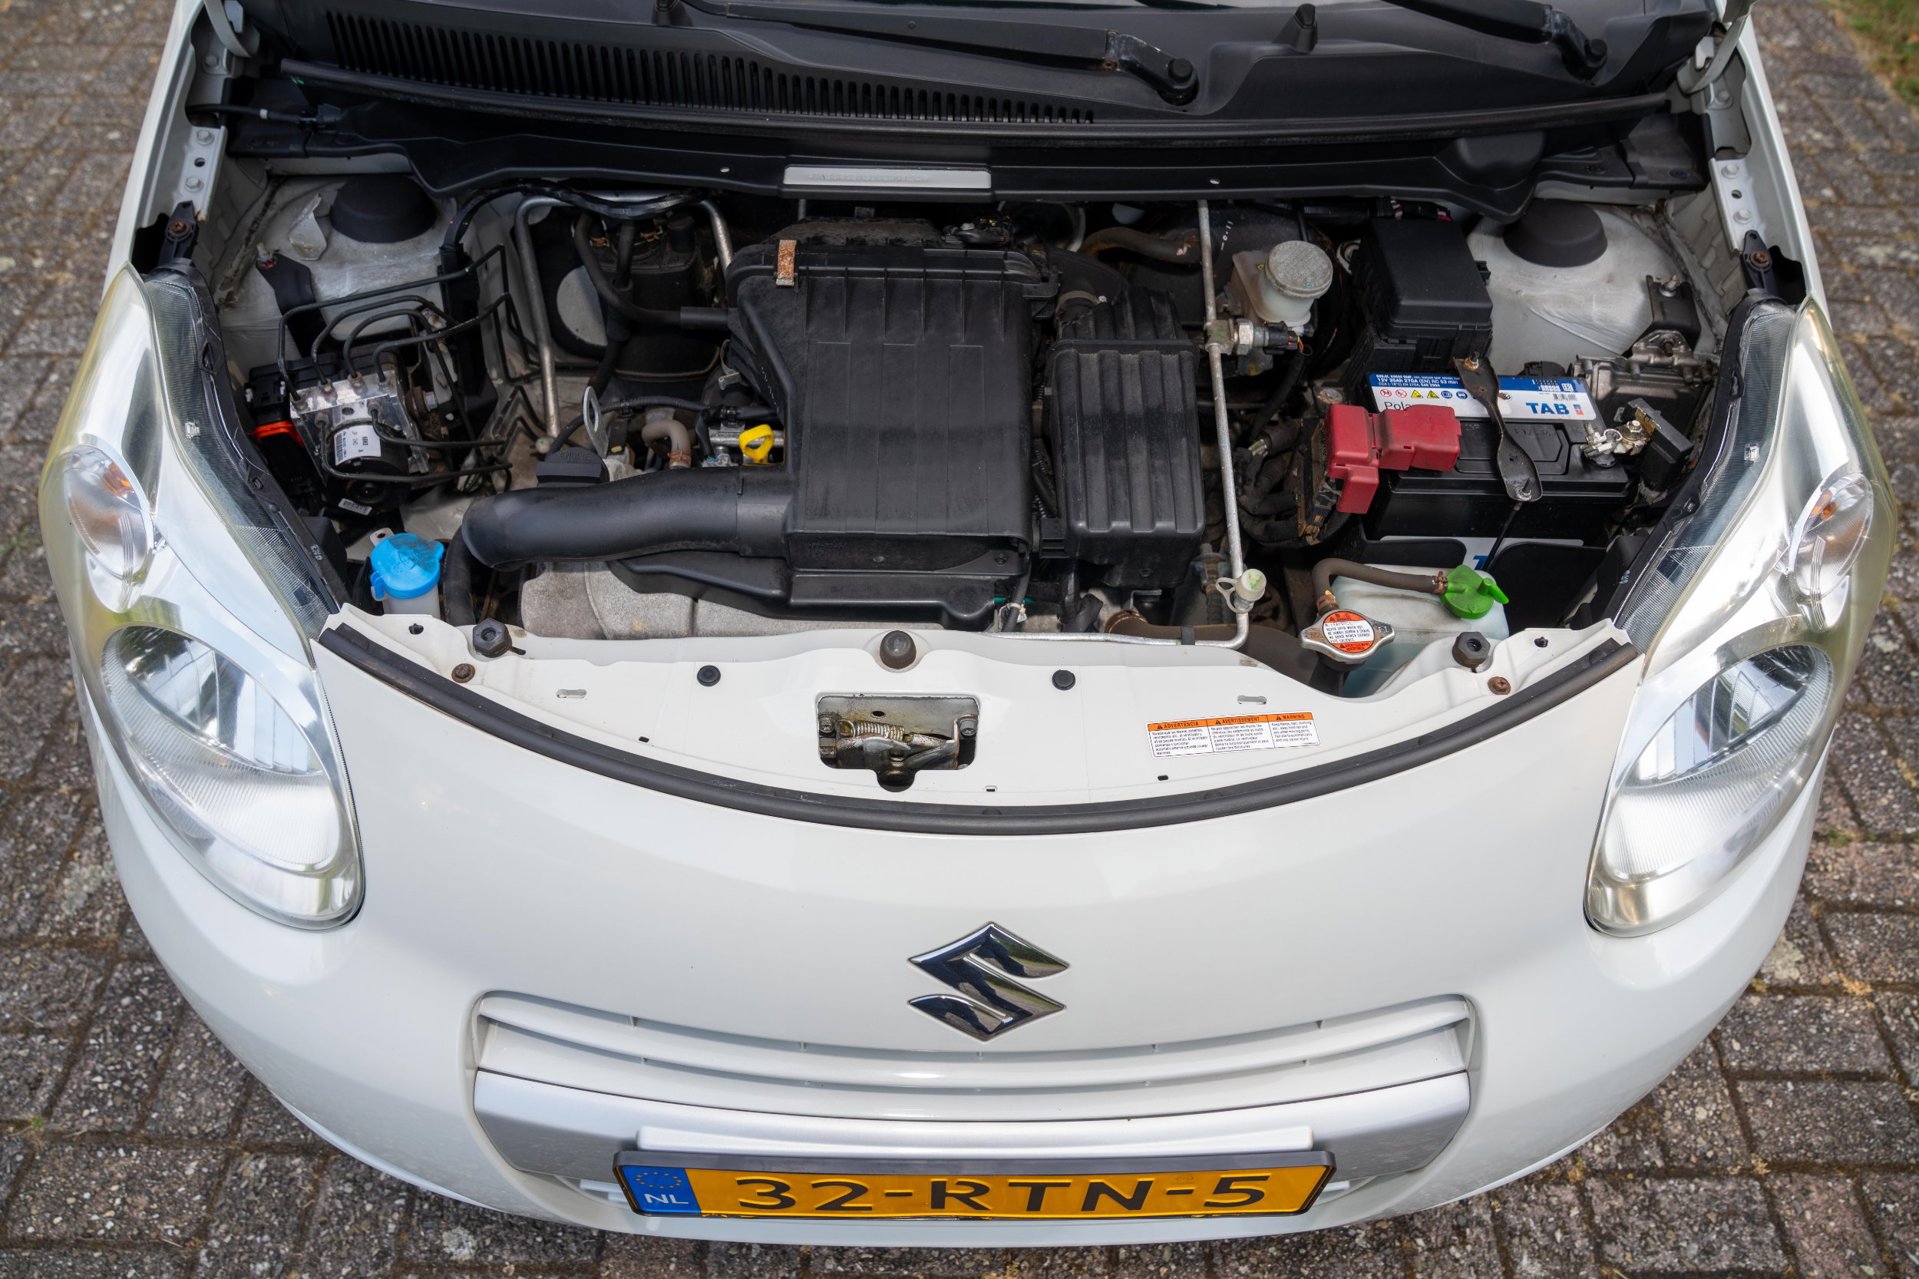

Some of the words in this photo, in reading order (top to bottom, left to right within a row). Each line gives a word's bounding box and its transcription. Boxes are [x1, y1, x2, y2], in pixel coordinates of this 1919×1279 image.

[1526, 402, 1570, 415] TAB
[1164, 721, 1199, 729] ADVERTENCIA
[646, 1193, 689, 1205] NL
[736, 1175, 1272, 1212] 32-RTN-5
